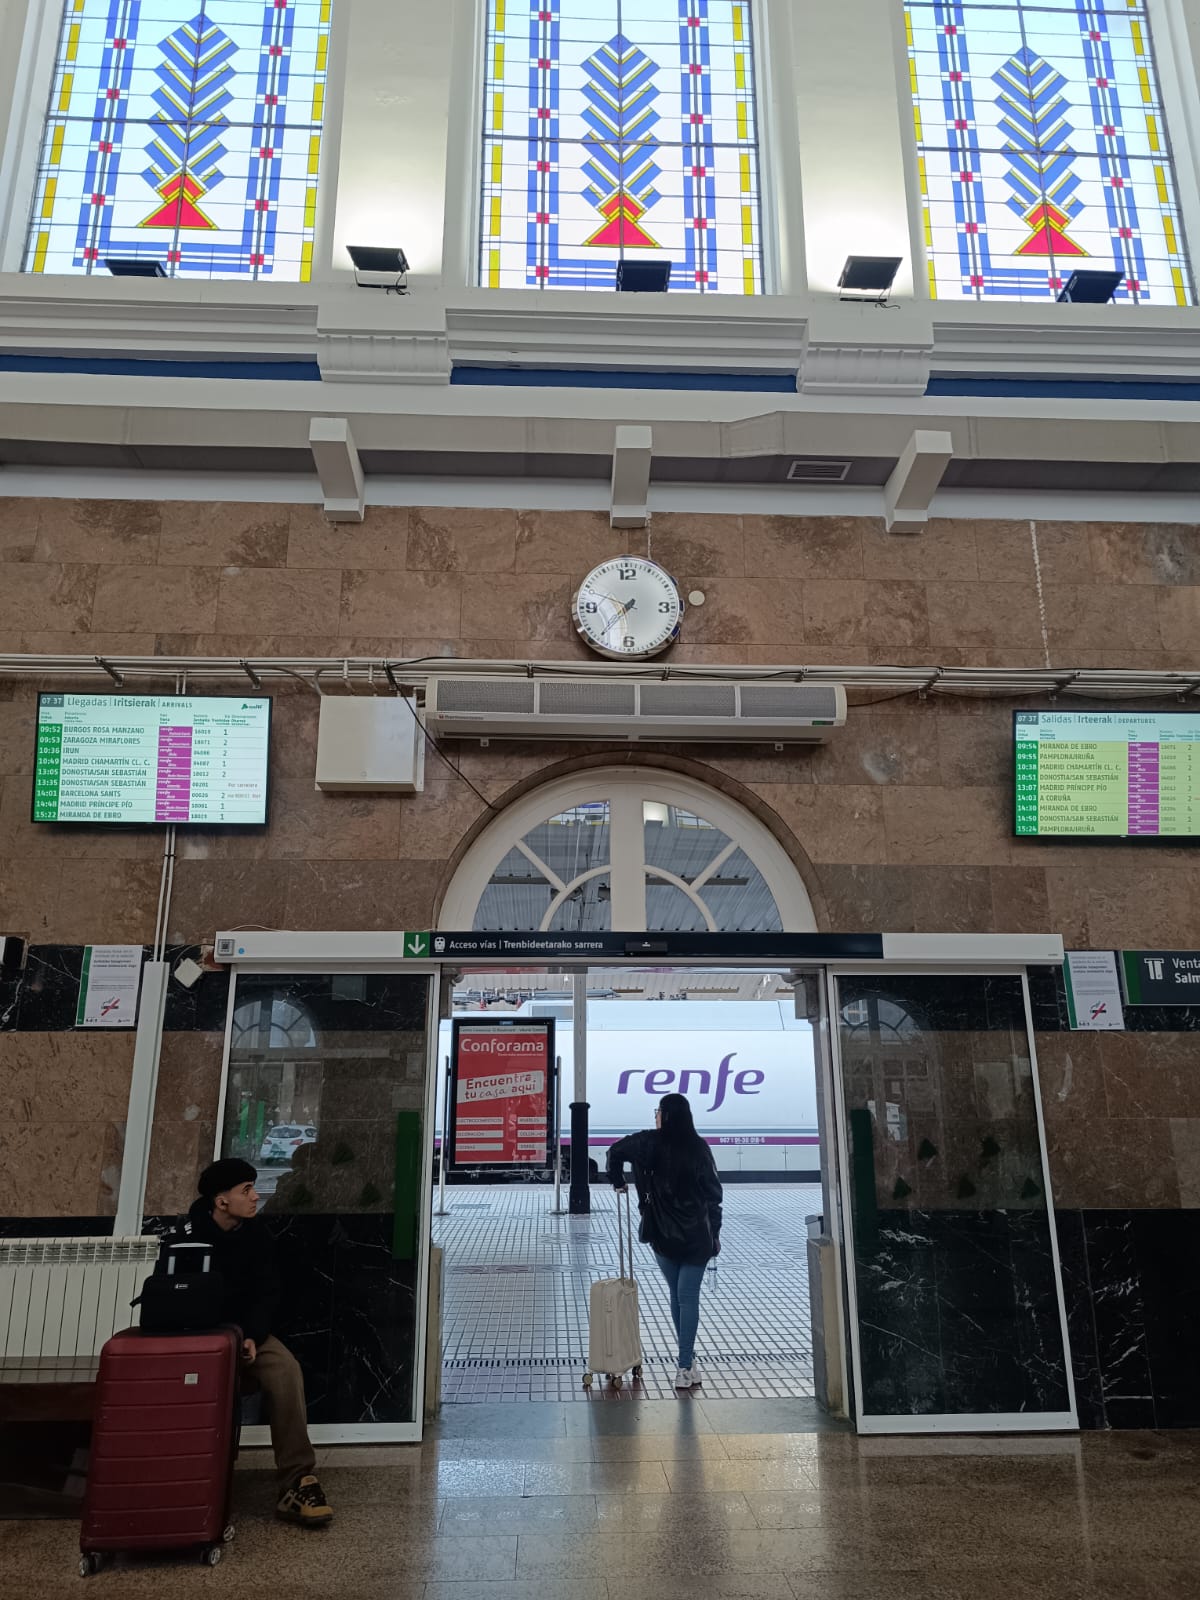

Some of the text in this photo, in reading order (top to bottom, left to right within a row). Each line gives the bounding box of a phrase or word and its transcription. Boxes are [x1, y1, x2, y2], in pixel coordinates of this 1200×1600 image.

[618, 569, 637, 580] 12
[585, 602, 597, 613] 9
[658, 602, 670, 613] 3
[623, 636, 635, 647] 6
[67, 697, 107, 707] Llegadas
[114, 698, 156, 707] Iritsierak
[1041, 715, 1072, 724] Salidas
[1078, 715, 1112, 724] Irteerak
[1040, 752, 1095, 760] PAMPLONA/IRUÑA
[62, 757, 89, 765] MADRID
[91, 757, 130, 766] CHAMARTÍN
[111, 769, 147, 777] SEBASTIÁN
[1086, 773, 1119, 781] SEBASTIÁN
[111, 779, 147, 787] SEBASTIÁN
[1066, 783, 1094, 791] PRÍNCIPE
[1096, 783, 1107, 791] PÍO
[89, 800, 119, 808] PRÍNCIPE
[121, 800, 133, 808] PÍO
[1086, 814, 1119, 822] SEBASTIÁN
[449, 941, 477, 949] Acceso
[480, 940, 497, 949] vías
[504, 940, 572, 949] Trenbideetarako
[461, 1038, 544, 1053] Conforama
[466, 1073, 532, 1090] Encuentra
[617, 1052, 765, 1112] renfe
[465, 1092, 477, 1100] tu
